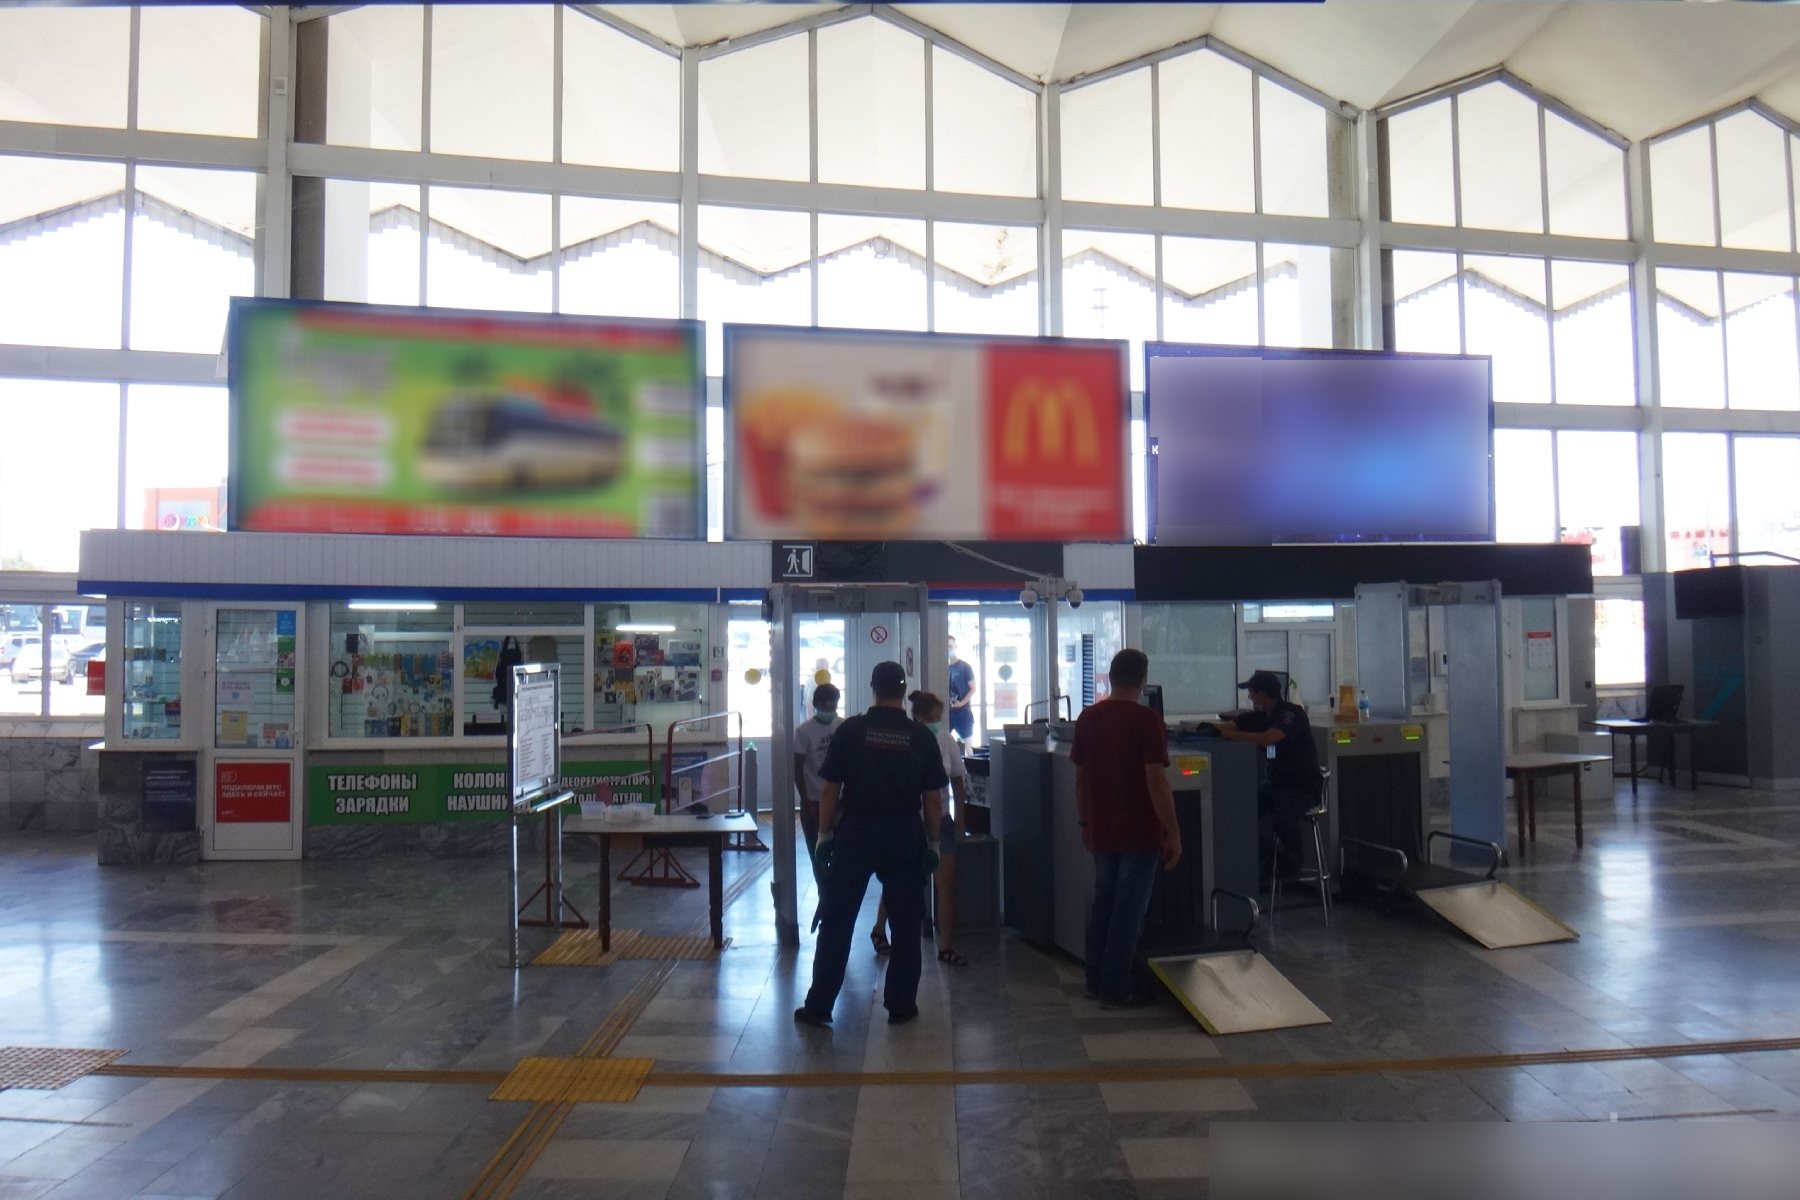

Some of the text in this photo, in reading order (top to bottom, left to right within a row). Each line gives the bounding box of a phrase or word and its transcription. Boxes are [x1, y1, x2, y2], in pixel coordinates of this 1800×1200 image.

[327, 773, 417, 791] ТЕЛЕФОНЫ
[453, 772, 508, 789] КОЛОН
[335, 796, 410, 815] ЗАРЯДКИ
